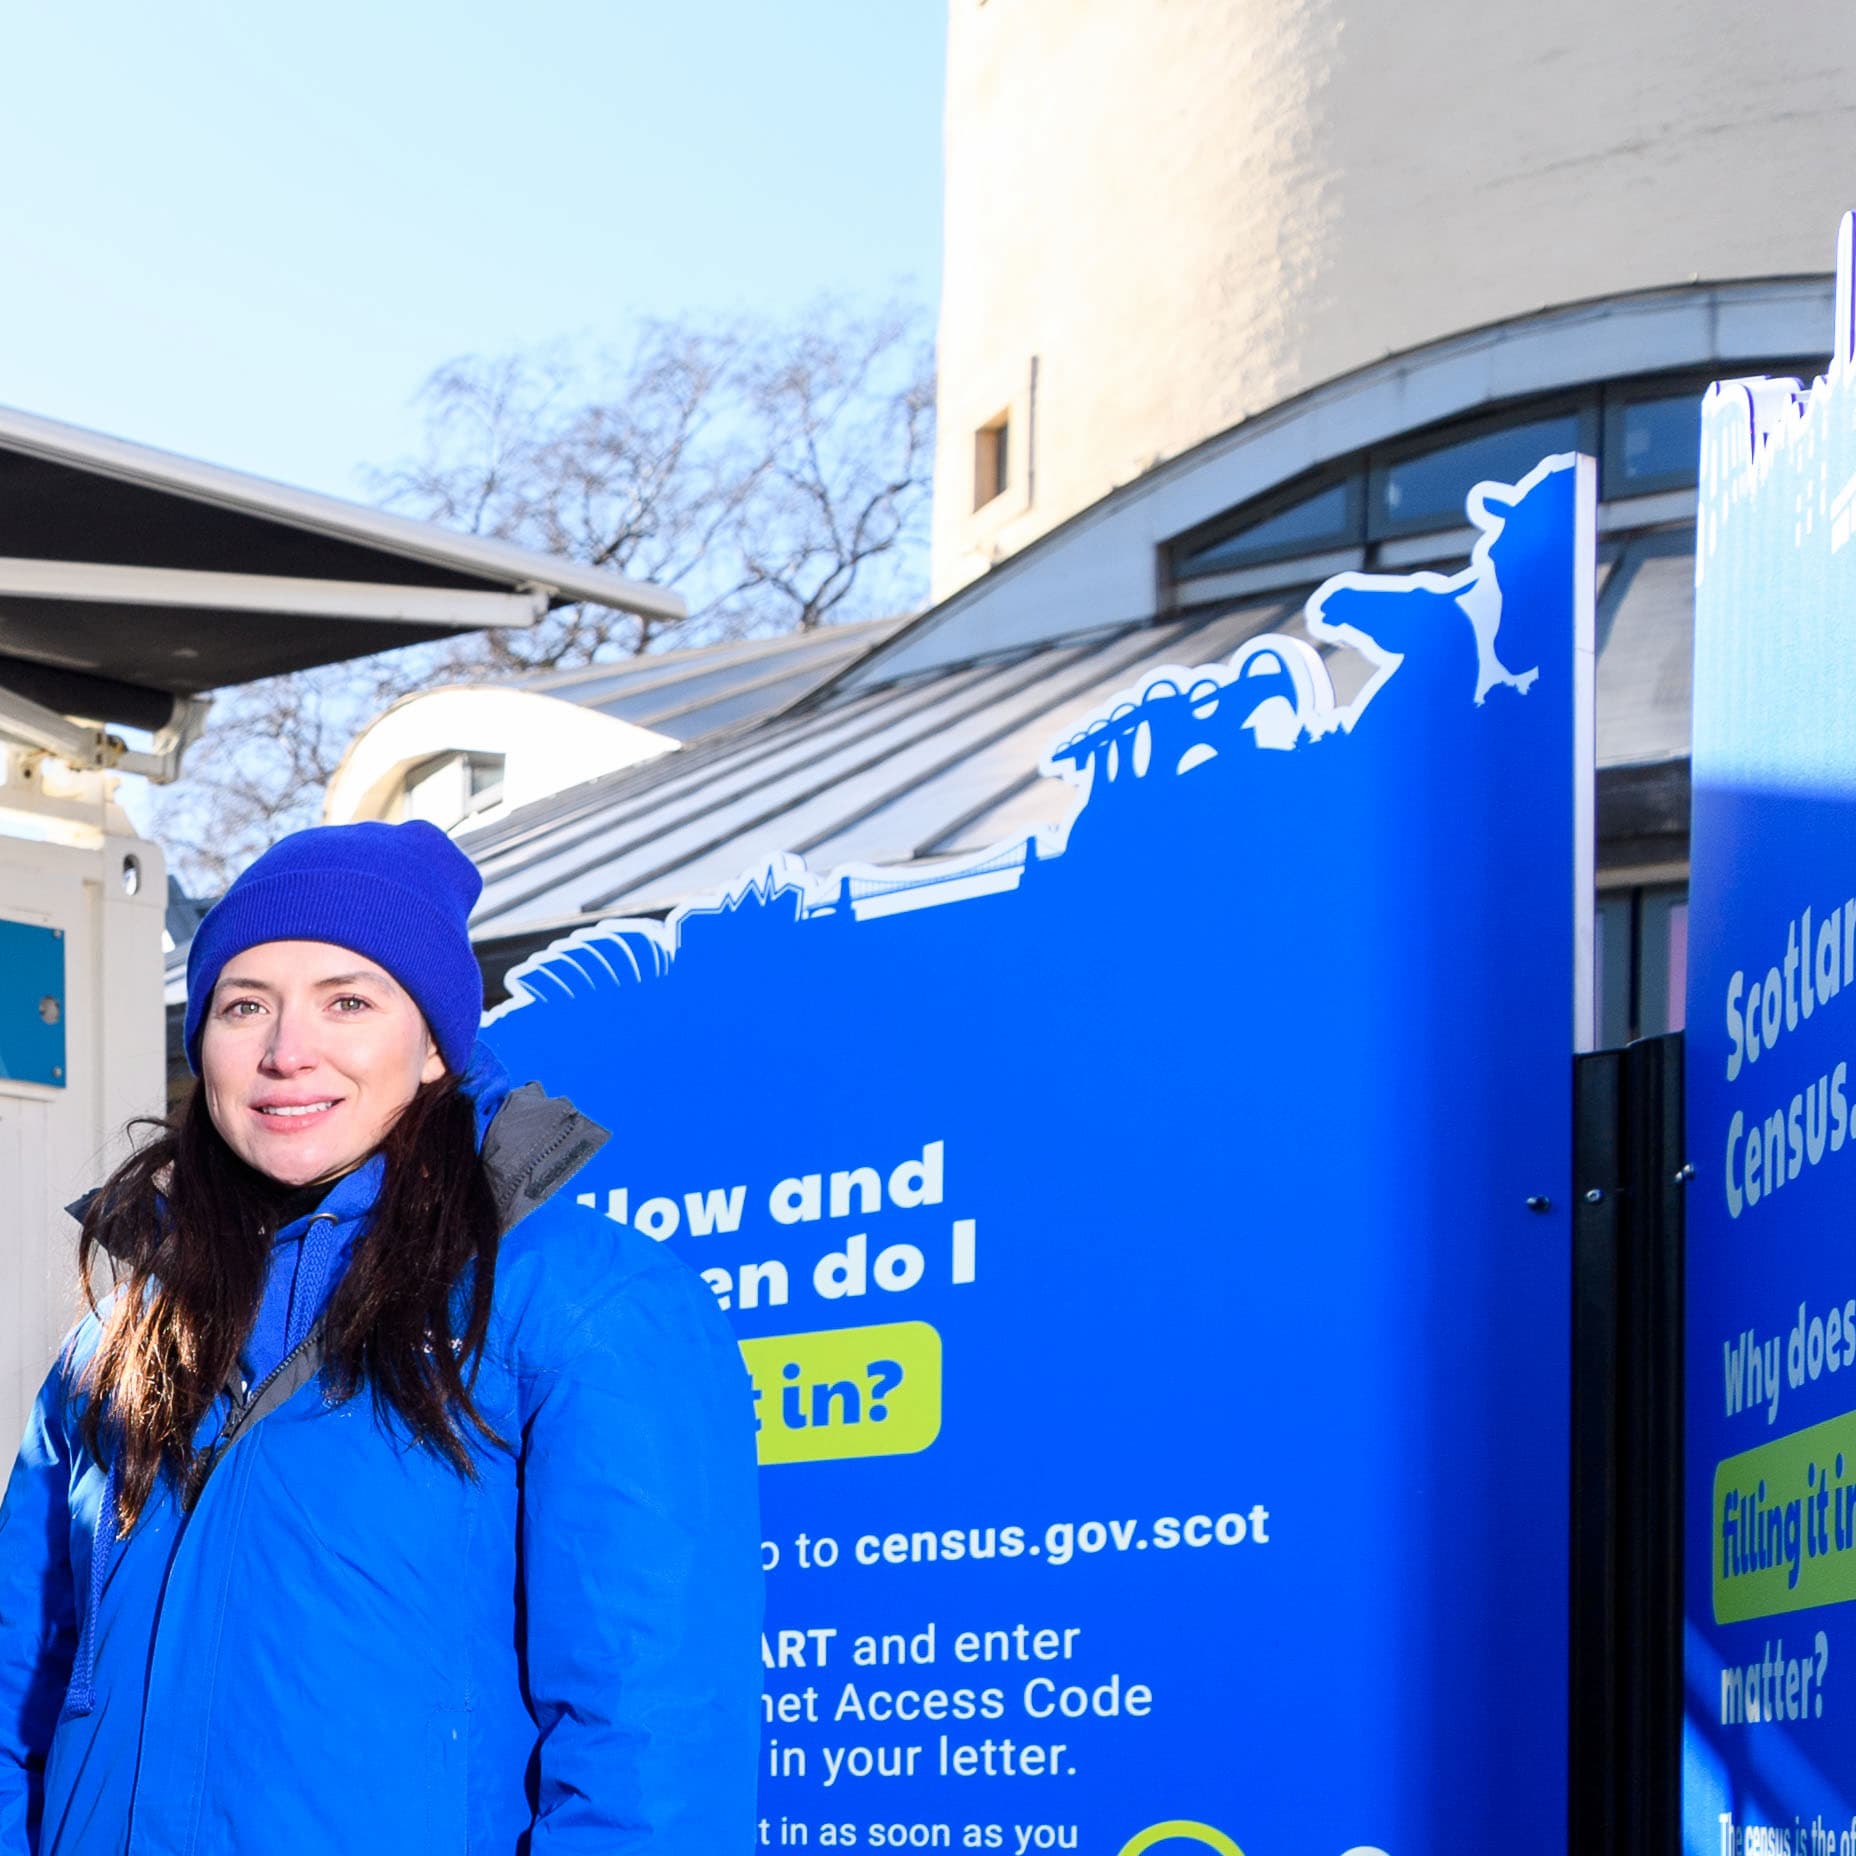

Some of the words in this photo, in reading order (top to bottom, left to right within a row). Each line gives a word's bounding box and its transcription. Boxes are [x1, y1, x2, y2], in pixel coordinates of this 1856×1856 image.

[769, 1140, 944, 1225] and
[813, 1232, 925, 1300] do
[952, 1218, 976, 1285] I
[781, 1360, 906, 1430] in?
[1723, 1334, 1780, 1425] Why
[1788, 1298, 1856, 1390] does
[795, 1533, 839, 1569] to
[855, 1504, 1270, 1565] census.gov.scot
[1722, 1480, 1801, 1589] filling
[1807, 1461, 1829, 1557] it
[853, 1622, 935, 1666] and
[954, 1623, 1081, 1663] enter
[1721, 1631, 1828, 1725] matter?
[834, 1683, 1004, 1721] Access
[1023, 1674, 1153, 1718] Code
[771, 1739, 806, 1777] in
[822, 1746, 922, 1787] your
[940, 1735, 1076, 1776] letter.
[781, 1823, 808, 1845] in
[819, 1823, 857, 1846] as
[868, 1823, 950, 1847] soon
[963, 1824, 1003, 1848] as
[1014, 1824, 1078, 1856] you
